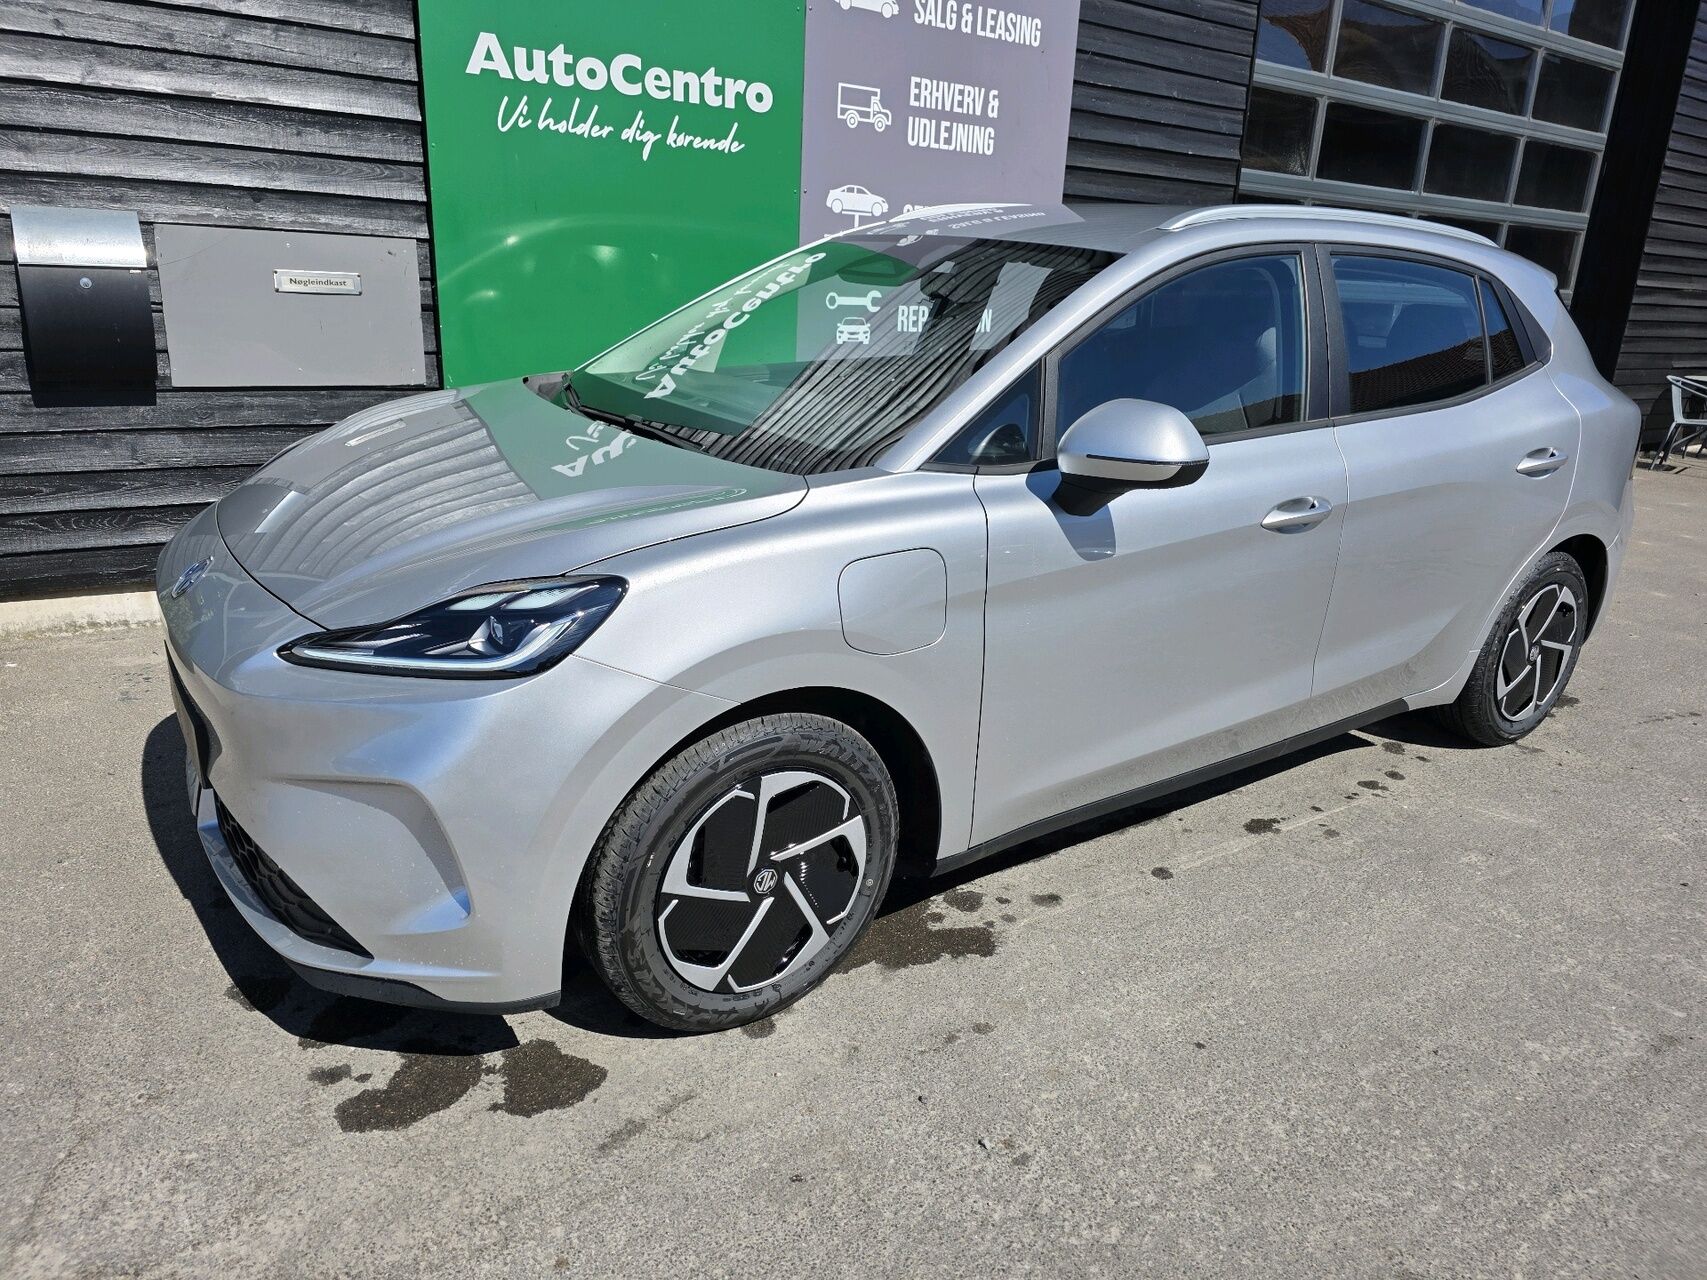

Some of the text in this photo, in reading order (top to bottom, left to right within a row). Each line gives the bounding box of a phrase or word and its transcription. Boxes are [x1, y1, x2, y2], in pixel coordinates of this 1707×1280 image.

[914, 0, 1041, 47] SALG & LEASING
[465, 31, 774, 113] AutoCentro
[909, 76, 1000, 118] ERHVERV &
[497, 95, 532, 133] Vi
[537, 97, 614, 140] holder
[620, 110, 662, 161] dig
[907, 116, 995, 156] UDLEJNING
[289, 277, 347, 287] Nøgleindkast
